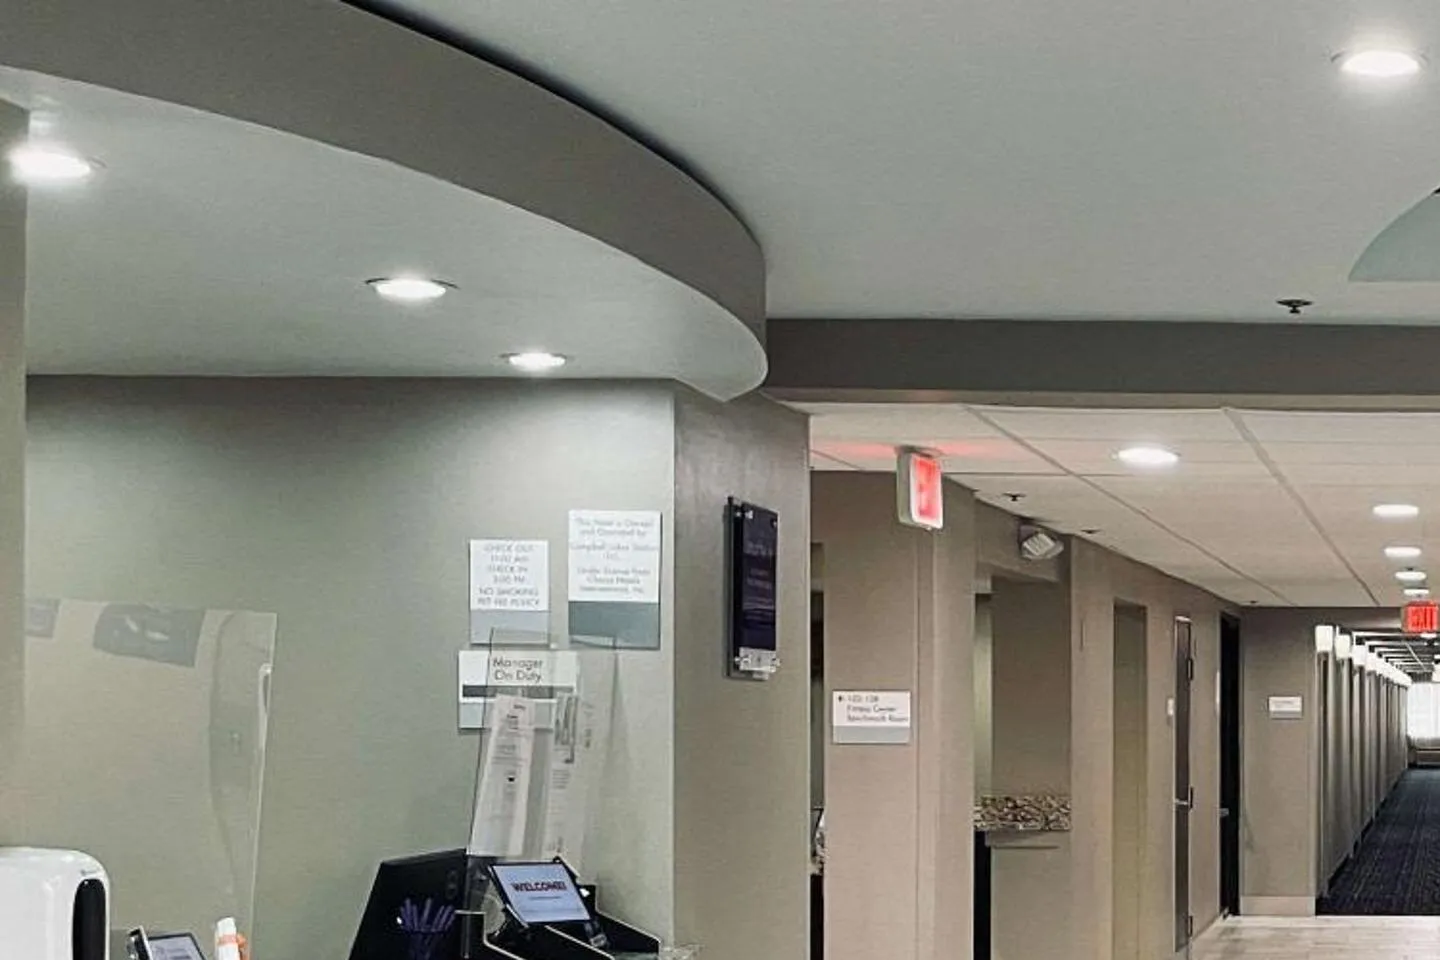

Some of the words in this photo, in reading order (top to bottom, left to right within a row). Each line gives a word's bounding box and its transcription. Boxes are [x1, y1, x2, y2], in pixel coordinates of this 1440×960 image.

[493, 657, 542, 671] Manager
[494, 670, 513, 681] On
[516, 669, 542, 683] Duty
